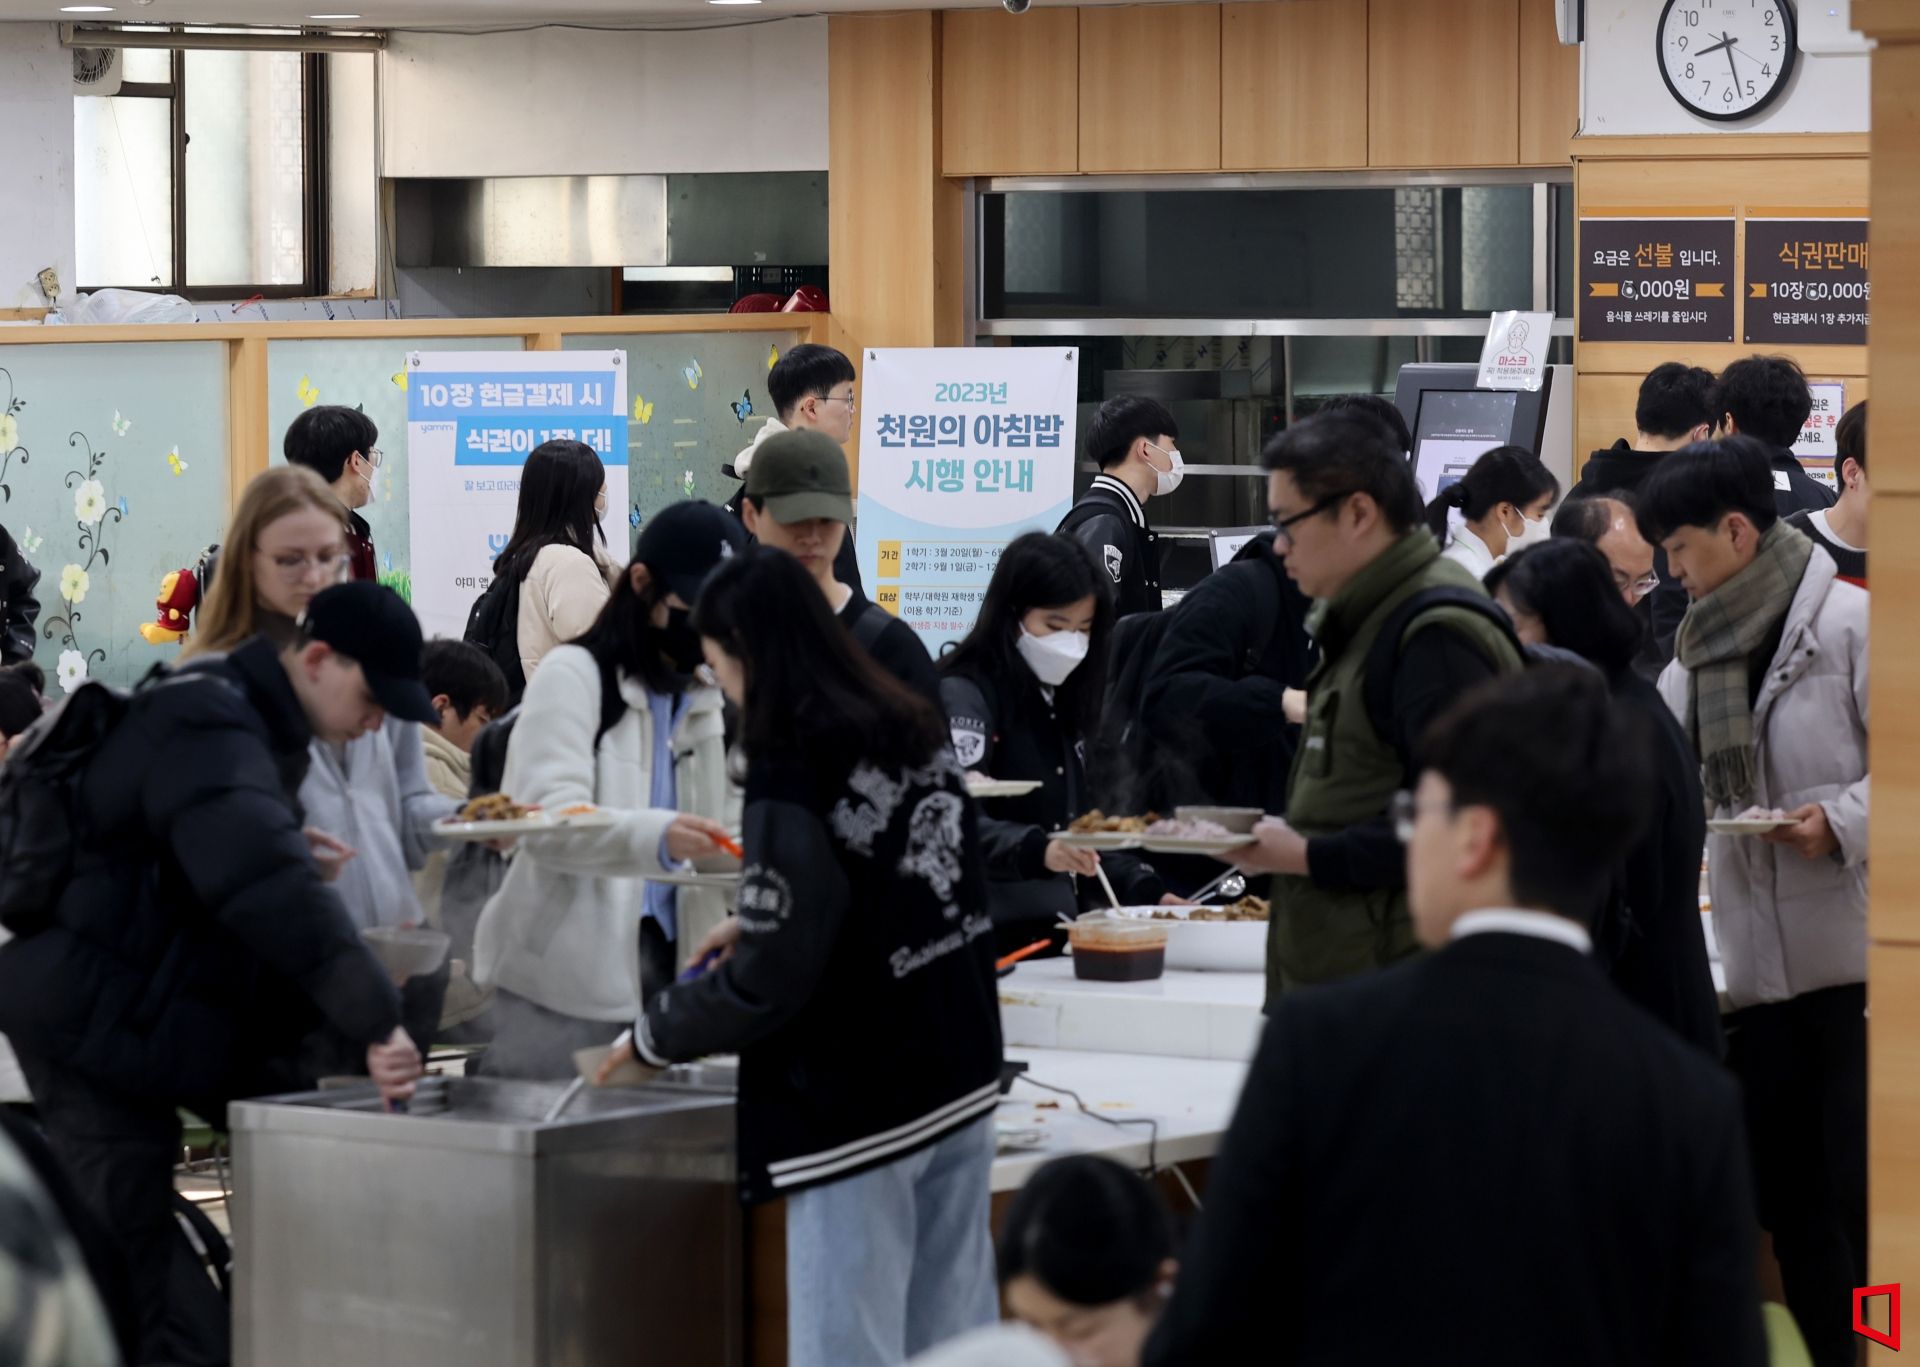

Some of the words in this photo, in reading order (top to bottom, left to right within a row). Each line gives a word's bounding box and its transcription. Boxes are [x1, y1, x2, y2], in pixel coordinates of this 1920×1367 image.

[1684, 10, 1699, 27] 10
[1764, 10, 1774, 26] 2
[1678, 36, 1688, 52] 9
[1770, 35, 1780, 51] 3
[1685, 62, 1695, 79] 8
[1761, 62, 1772, 78] 4
[1702, 80, 1711, 96] 7
[1723, 86, 1733, 103] 6
[1746, 80, 1755, 96] 5
[1593, 250, 1631, 266] 요금은
[1634, 242, 1674, 268] 선불
[1679, 249, 1721, 267] 입니다.
[1778, 241, 1869, 270] 식권판매
[1605, 310, 1633, 323] 음식물
[1634, 310, 1670, 323] 쓰레기를
[1671, 310, 1708, 324] 줄입시다
[1772, 312, 1818, 325] 현금결제시
[1820, 313, 1835, 325] 1장
[1498, 356, 1527, 366] 마스크
[420, 383, 474, 407] 10장
[479, 382, 573, 407] 현금결제
[579, 383, 602, 407] 시
[935, 382, 1008, 404] 2023년
[420, 423, 454, 434] yammi
[1826, 414, 1836, 428] 후
[876, 413, 966, 448] 천원의
[973, 413, 1065, 448] 아침밥
[465, 428, 535, 453] 식권이
[581, 428, 612, 452] 더!
[904, 457, 965, 493] 시행
[973, 458, 1034, 493] 안내
[476, 480, 496, 491] 보고
[881, 550, 899, 560] 기간
[906, 547, 927, 557] 1학기
[934, 547, 948, 557] 3월
[905, 562, 926, 572] 2학기
[933, 562, 948, 572] 9월
[455, 577, 476, 588] 야미
[478, 576, 489, 589] 앱
[879, 592, 897, 602] 대상
[904, 592, 949, 602] 학부/대학원
[951, 592, 975, 602] 재학생
[925, 606, 941, 616] 학기
